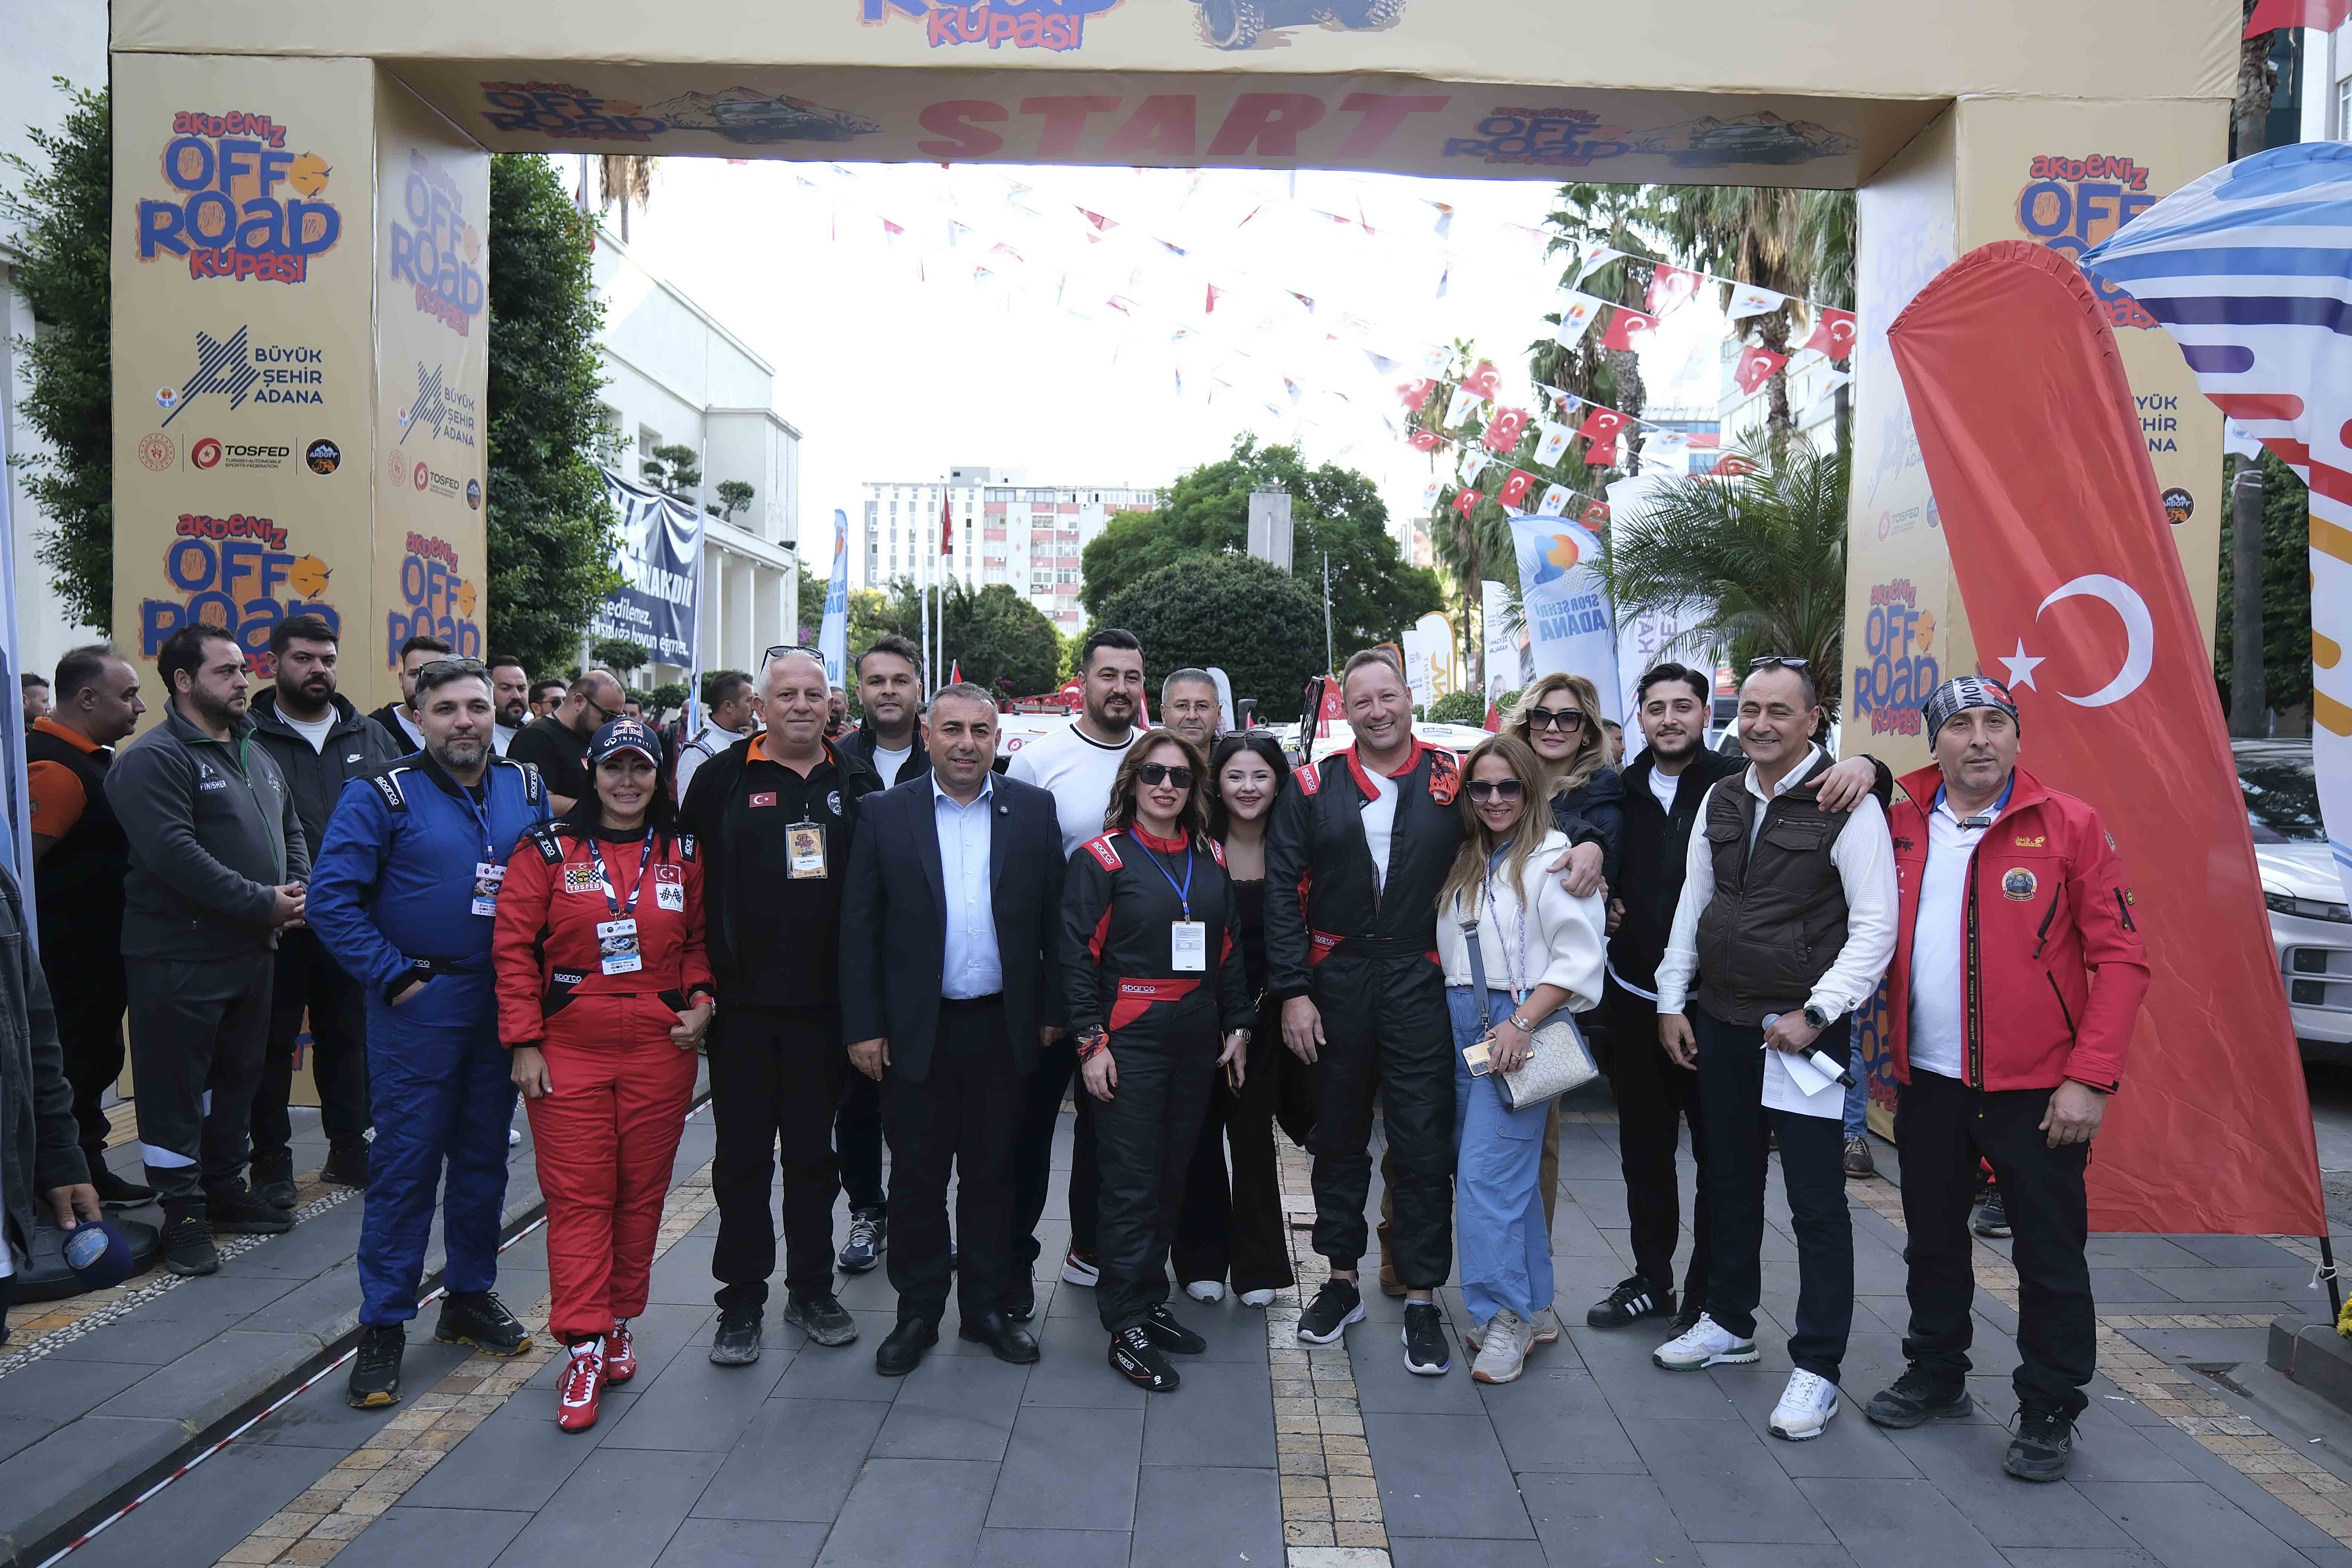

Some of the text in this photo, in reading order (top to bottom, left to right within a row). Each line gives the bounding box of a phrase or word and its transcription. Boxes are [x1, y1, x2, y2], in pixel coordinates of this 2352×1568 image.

[917, 93, 1451, 157] START
[1478, 116, 1602, 141] OFF
[165, 136, 294, 197] OFF
[406, 173, 466, 252] OFF
[2020, 181, 2156, 245] OFF
[255, 346, 322, 364] BÜYÜK
[263, 367, 323, 387] ŞEHİR
[254, 389, 323, 404] ADANA
[444, 387, 474, 412] BÜYÜK
[2132, 394, 2177, 410] YÜK
[447, 408, 474, 430] ŞEHİR
[2138, 414, 2177, 432] HİR
[443, 425, 475, 448] ADANA
[225, 445, 290, 457] TOSFED
[430, 471, 459, 490] TOSFED
[168, 539, 296, 599] OFF
[400, 554, 461, 612] OFF
[1866, 604, 1919, 657] OFF
[612, 727, 643, 738] Red Bull
[200, 780, 228, 791] FINISHER
[1302, 767, 1316, 791] sparco
[375, 776, 400, 805] sparco
[1092, 841, 1115, 865] sparco
[1314, 935, 1334, 946] sparco
[554, 973, 582, 983] sparco
[1122, 984, 1155, 993] sparco
[1117, 1352, 1134, 1370] sparco
